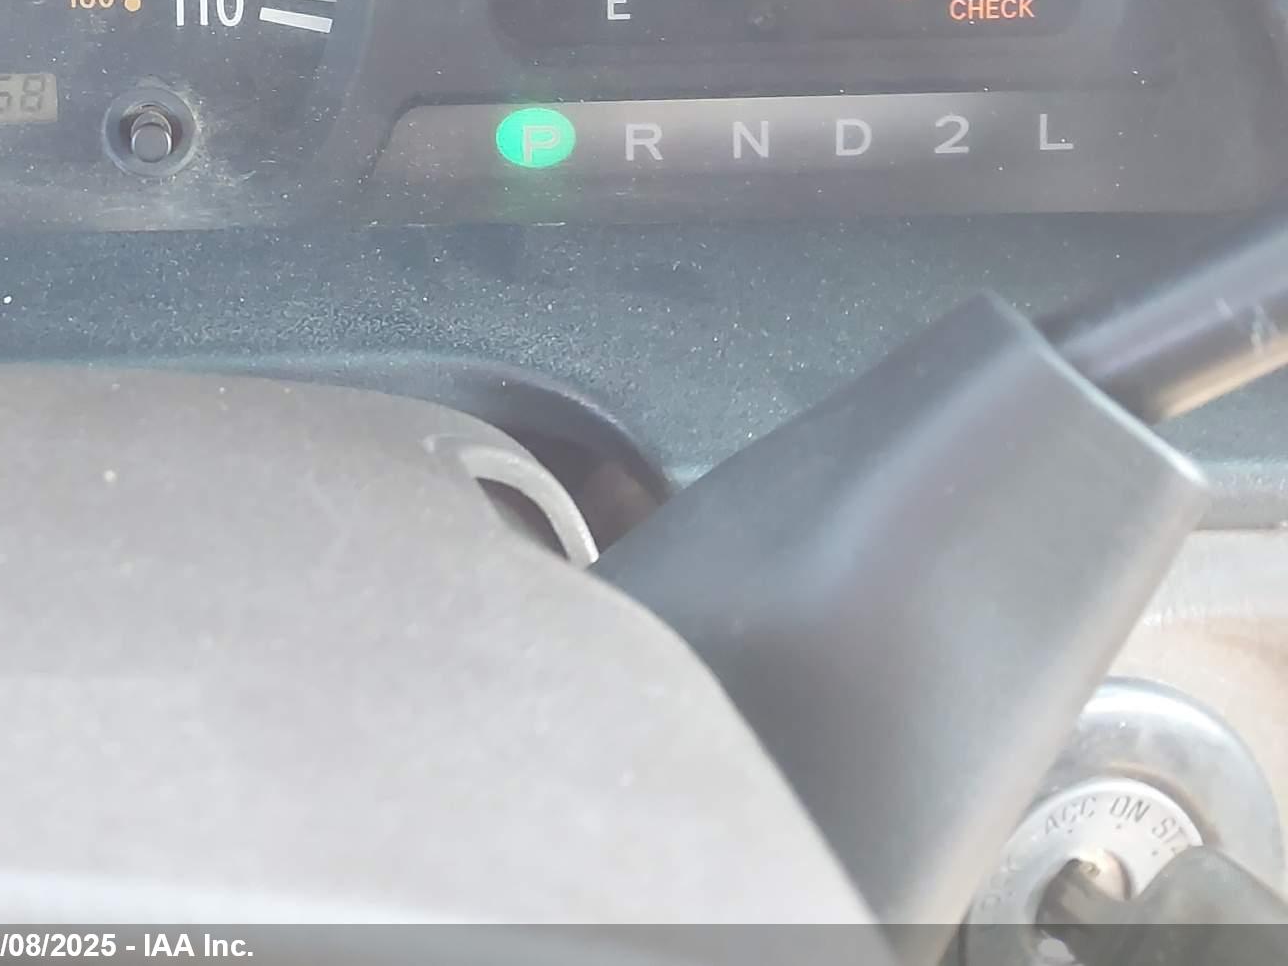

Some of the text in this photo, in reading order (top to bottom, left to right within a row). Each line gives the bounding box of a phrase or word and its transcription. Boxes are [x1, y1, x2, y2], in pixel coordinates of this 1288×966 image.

[522, 112, 1073, 164] P R N D 2 L
[1047, 797, 1096, 832] ACC
[1110, 795, 1149, 823] ON
